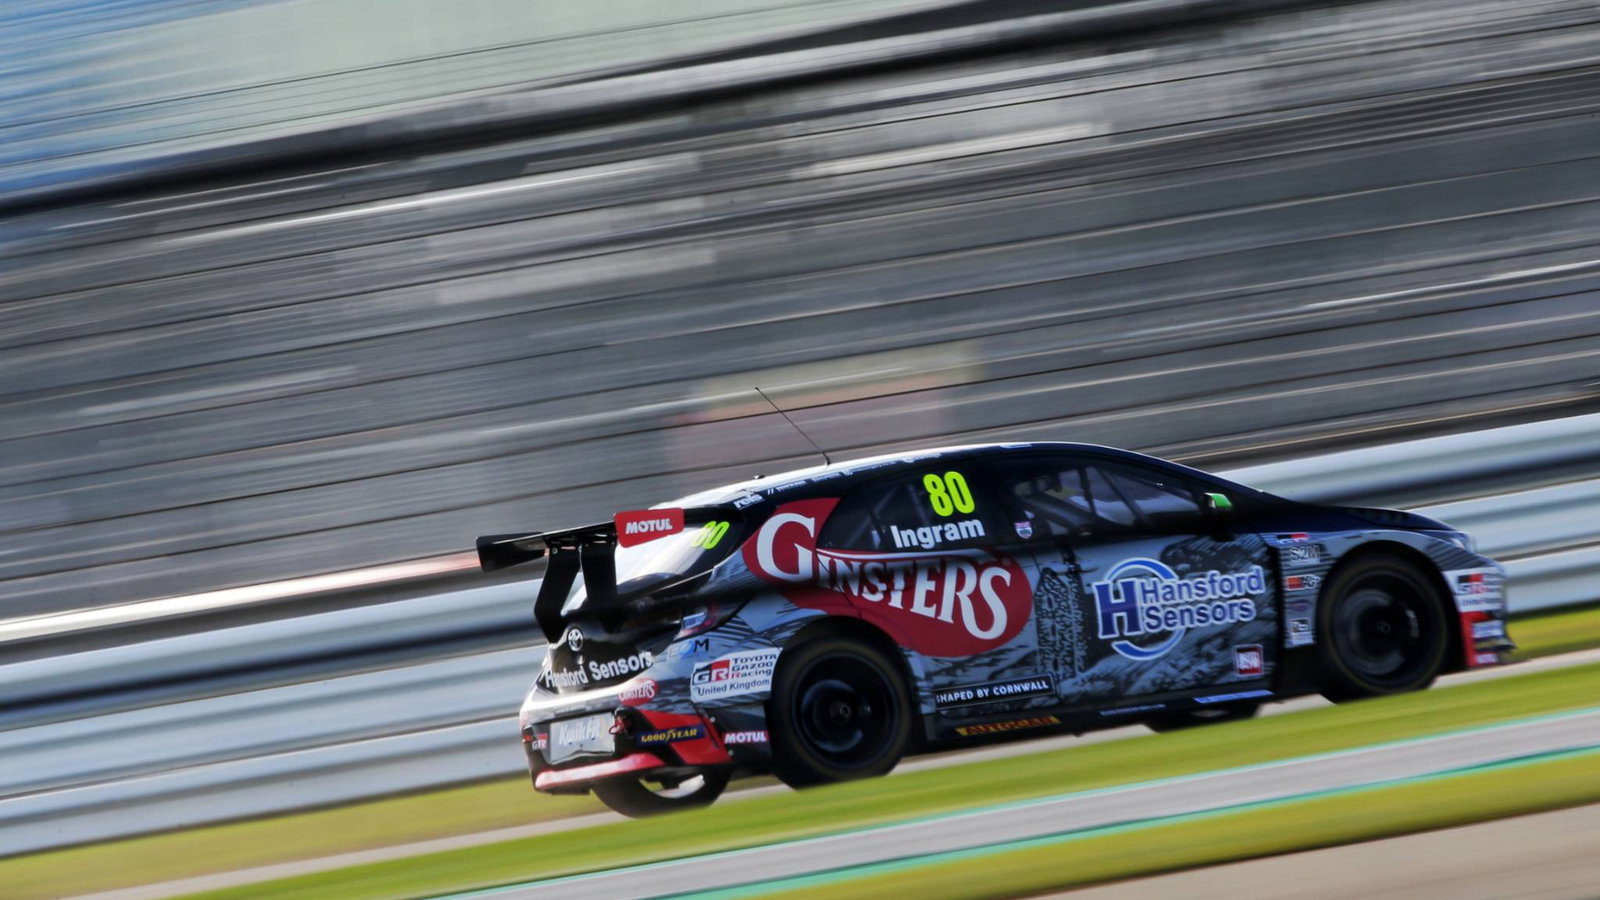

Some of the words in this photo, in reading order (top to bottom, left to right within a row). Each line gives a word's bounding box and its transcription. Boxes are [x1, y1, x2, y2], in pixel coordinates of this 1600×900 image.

[923, 471, 975, 517] 80
[625, 518, 673, 535] MOTUL
[890, 519, 985, 549] Ingram
[757, 512, 1012, 640] GINSTERS
[1139, 566, 1265, 605] Hansford
[1144, 600, 1255, 632] Sensors
[588, 650, 653, 682] Sensors
[731, 661, 774, 672] GAZOO
[732, 653, 777, 665] TOYOTA
[731, 668, 772, 680] Racing
[697, 685, 727, 697] United
[729, 678, 770, 692] Kingdom
[976, 688, 990, 699] BY
[993, 680, 1049, 696] CORNWALL
[641, 728, 698, 743] GOODYEAR
[724, 731, 767, 744] MOTUL
